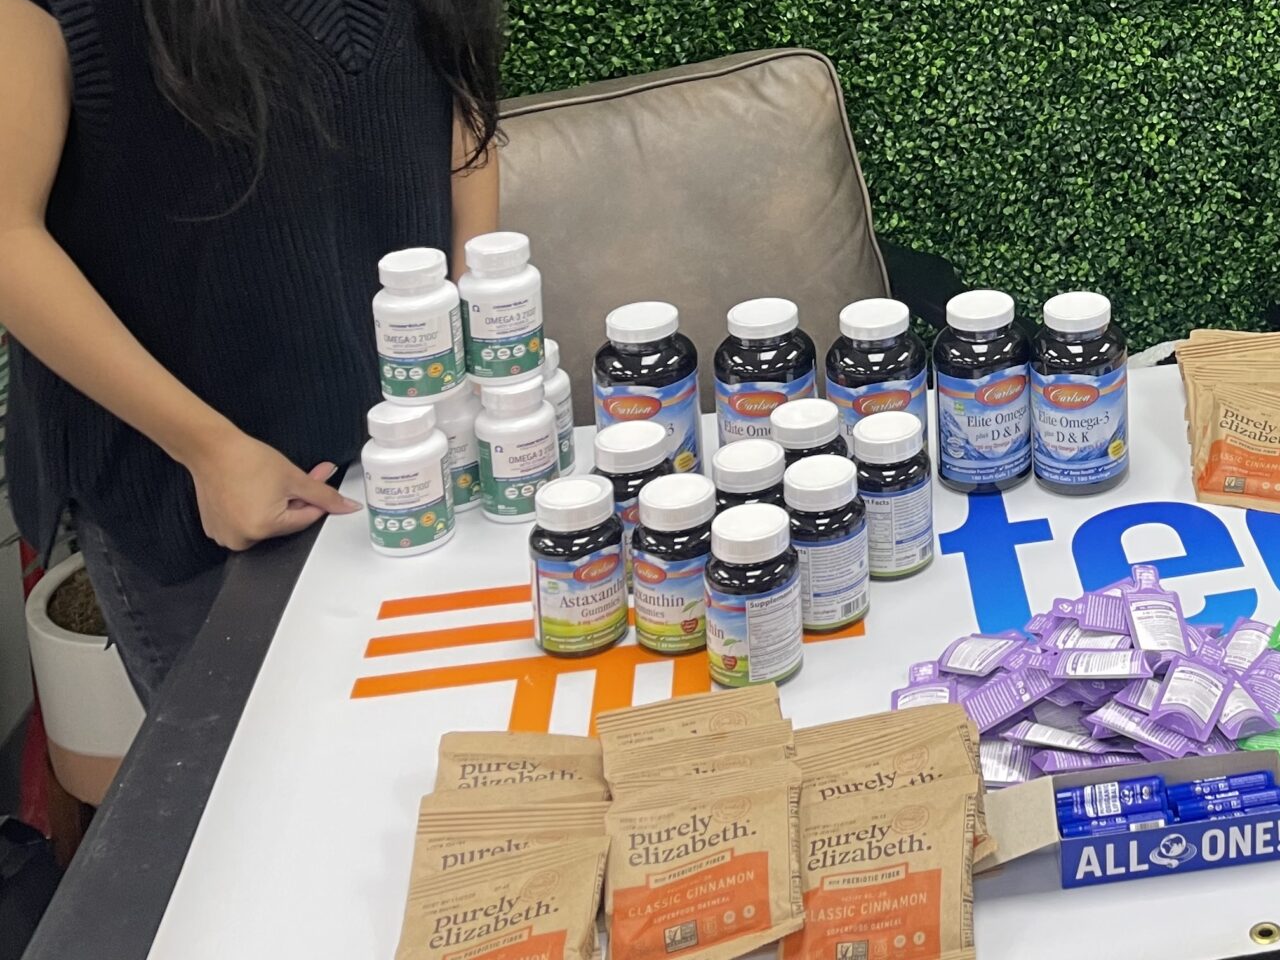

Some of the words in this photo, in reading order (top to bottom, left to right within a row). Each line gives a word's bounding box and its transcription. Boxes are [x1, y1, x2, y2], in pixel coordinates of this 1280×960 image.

[609, 397, 653, 415] Carlson
[1048, 386, 1091, 403] Carlson
[724, 421, 744, 436] Elite
[967, 415, 991, 428] Elite
[1059, 411, 1110, 431] Omega-3
[1223, 408, 1277, 435] purely
[1056, 431, 1065, 443] D
[1068, 432, 1078, 444] &
[1081, 431, 1090, 443] K
[750, 588, 793, 609] Supplement
[459, 760, 542, 781] purely
[818, 770, 898, 801] purely
[628, 820, 757, 867] elizabeth.
[629, 813, 714, 851] purely
[808, 824, 892, 858] purely
[807, 832, 933, 872] elizabeth.
[1075, 839, 1150, 880] ALL
[628, 892, 681, 918] CLASSIC
[686, 870, 755, 901] CINNAMON
[860, 891, 928, 916] CINNAMON
[429, 897, 559, 950] elizabeth.
[432, 895, 522, 935] purely
